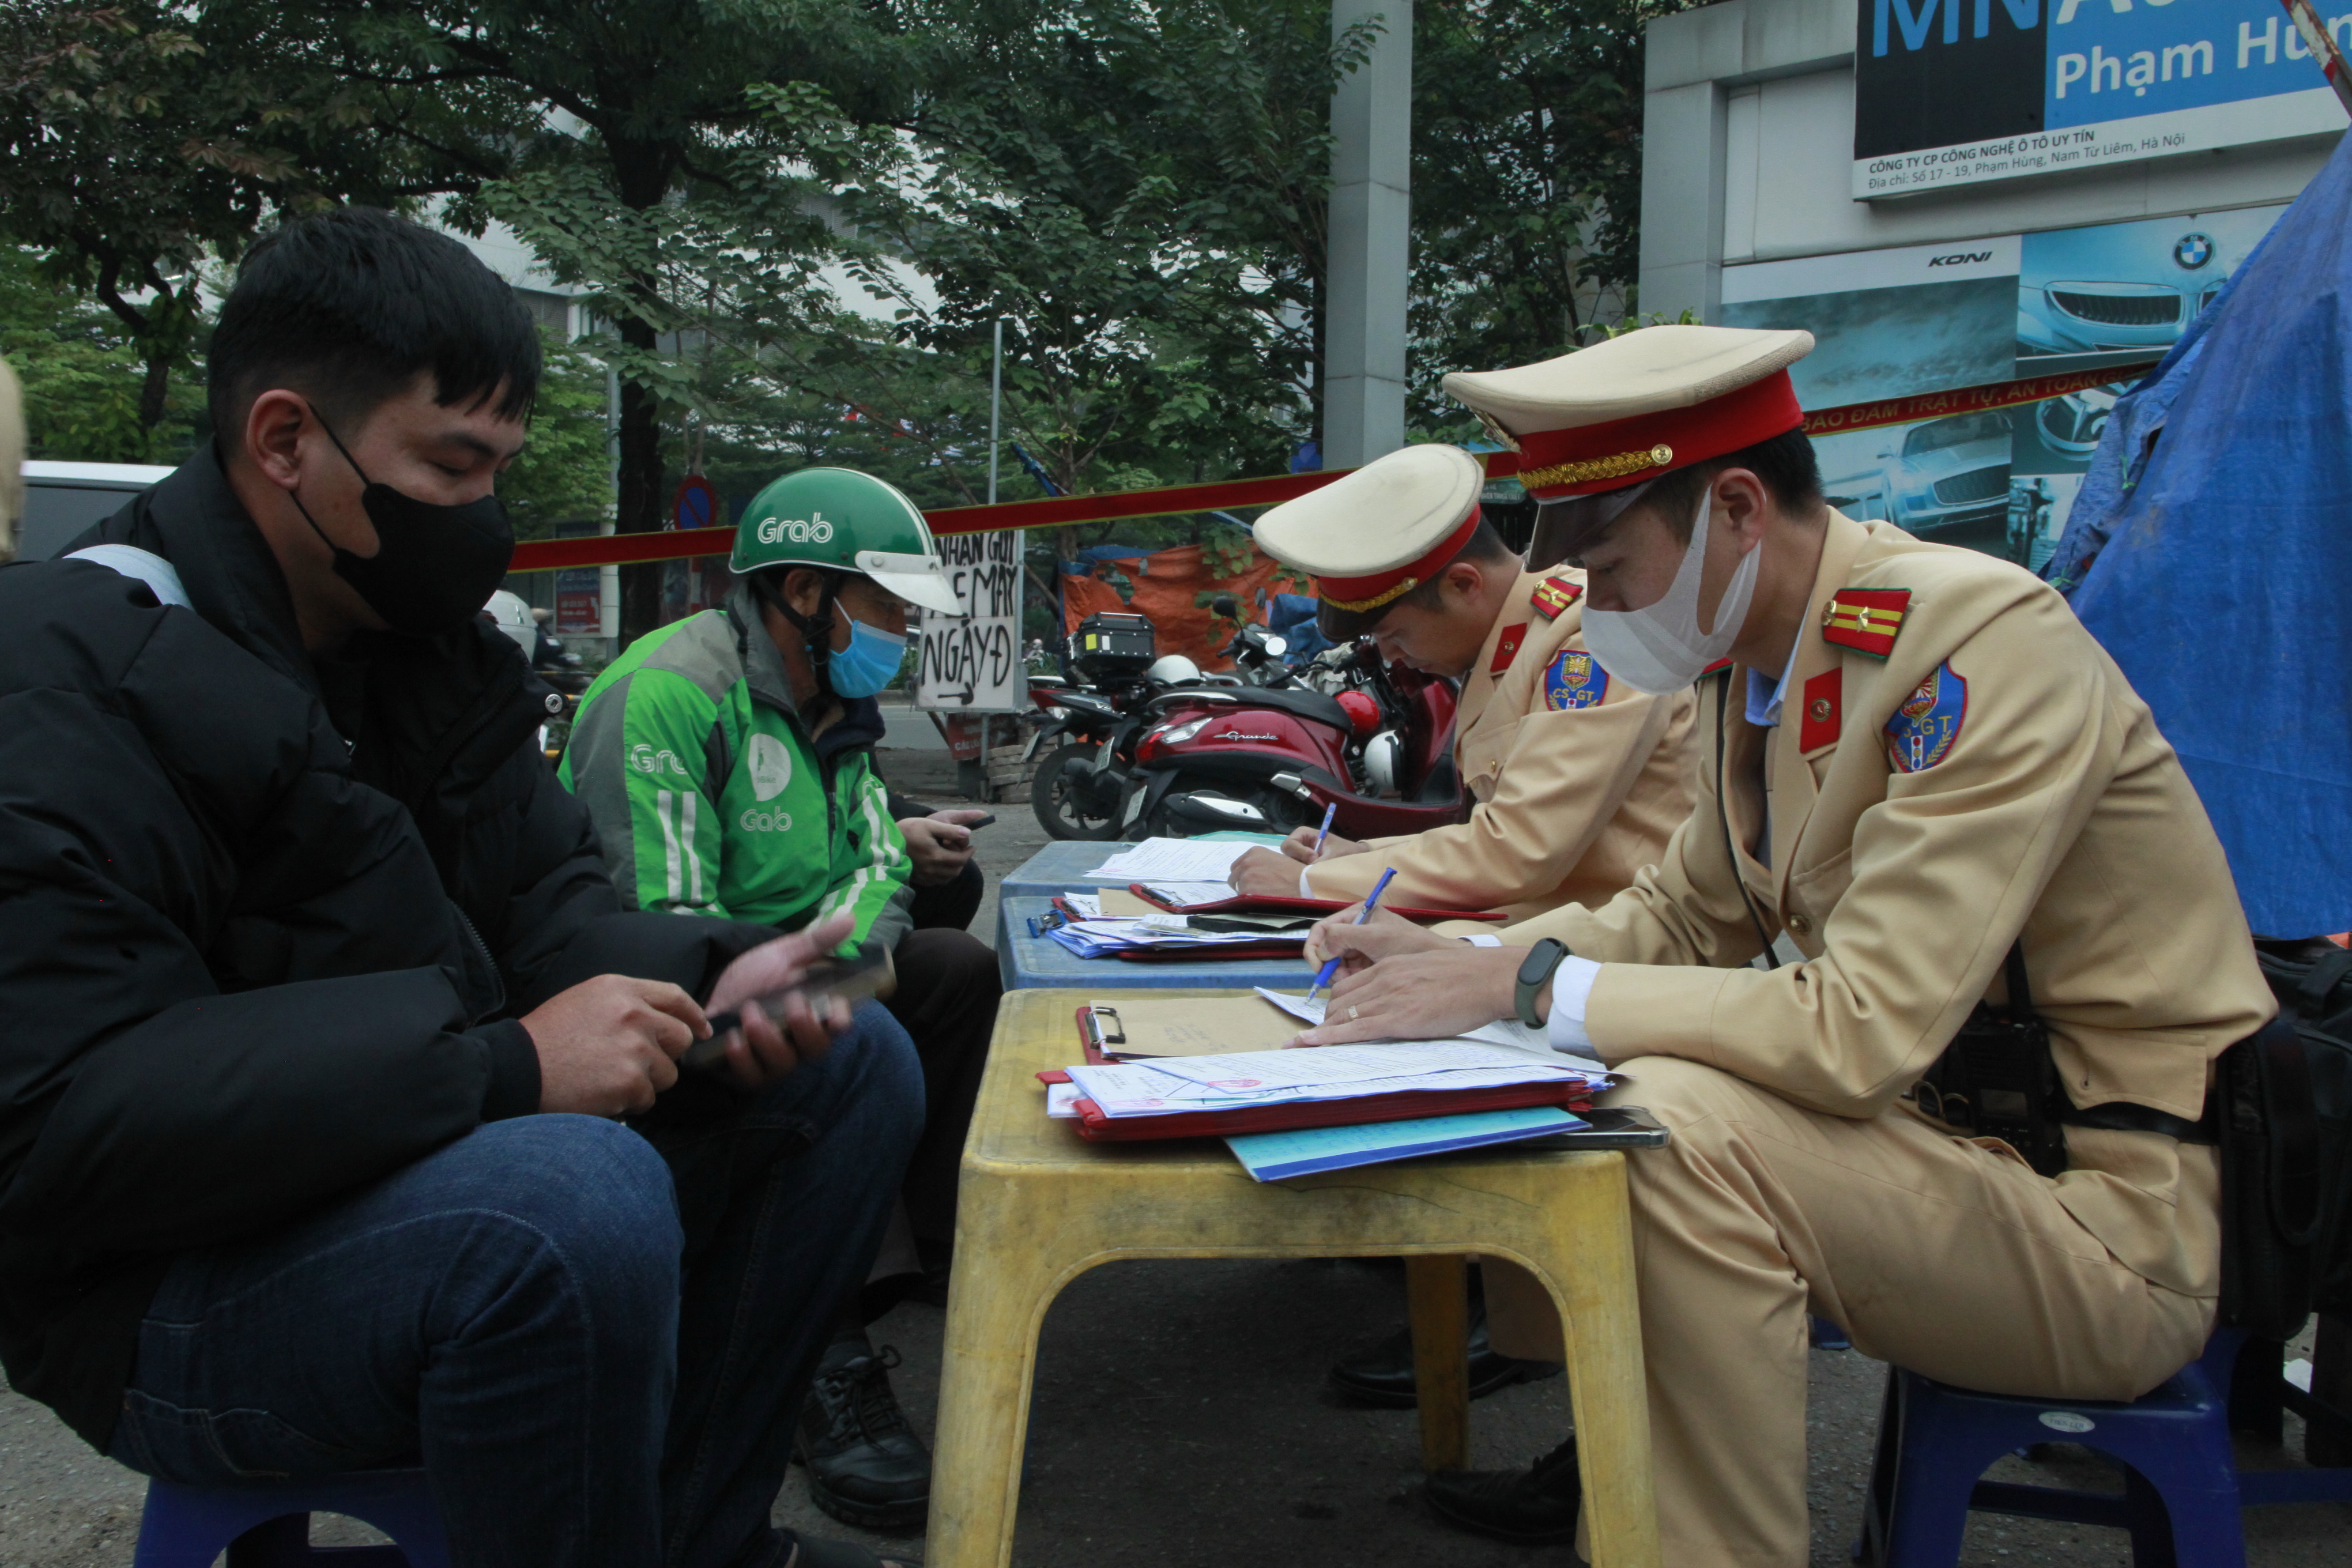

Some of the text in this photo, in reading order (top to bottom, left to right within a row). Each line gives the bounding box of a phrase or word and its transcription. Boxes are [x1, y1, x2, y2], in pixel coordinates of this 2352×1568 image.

[2056, 40, 2214, 99] Phạm
[1869, 160, 1902, 173] CÔNG
[1907, 157, 1920, 167] TY
[1923, 154, 1938, 165] CP
[1942, 149, 1976, 163] CÔNG
[1980, 140, 2014, 156] NGHỆ
[2032, 136, 2048, 149] TÔ
[2052, 134, 2070, 146] UY
[2074, 129, 2094, 143] TÍN
[1930, 168, 1943, 180] 17
[1955, 165, 1971, 177] 19,
[1976, 162, 2008, 174] Phạm
[2051, 150, 2079, 163] Nam
[2104, 143, 2136, 155] Liêm,
[2142, 137, 2158, 149] Hà
[2163, 133, 2185, 147] Nội
[1928, 251, 1992, 267] KONI
[2007, 382, 2036, 400] AN
[757, 512, 834, 544] Grab
[1552, 688, 1596, 701] CS GT
[1920, 715, 1953, 735] GT
[1213, 731, 1279, 741] Grande
